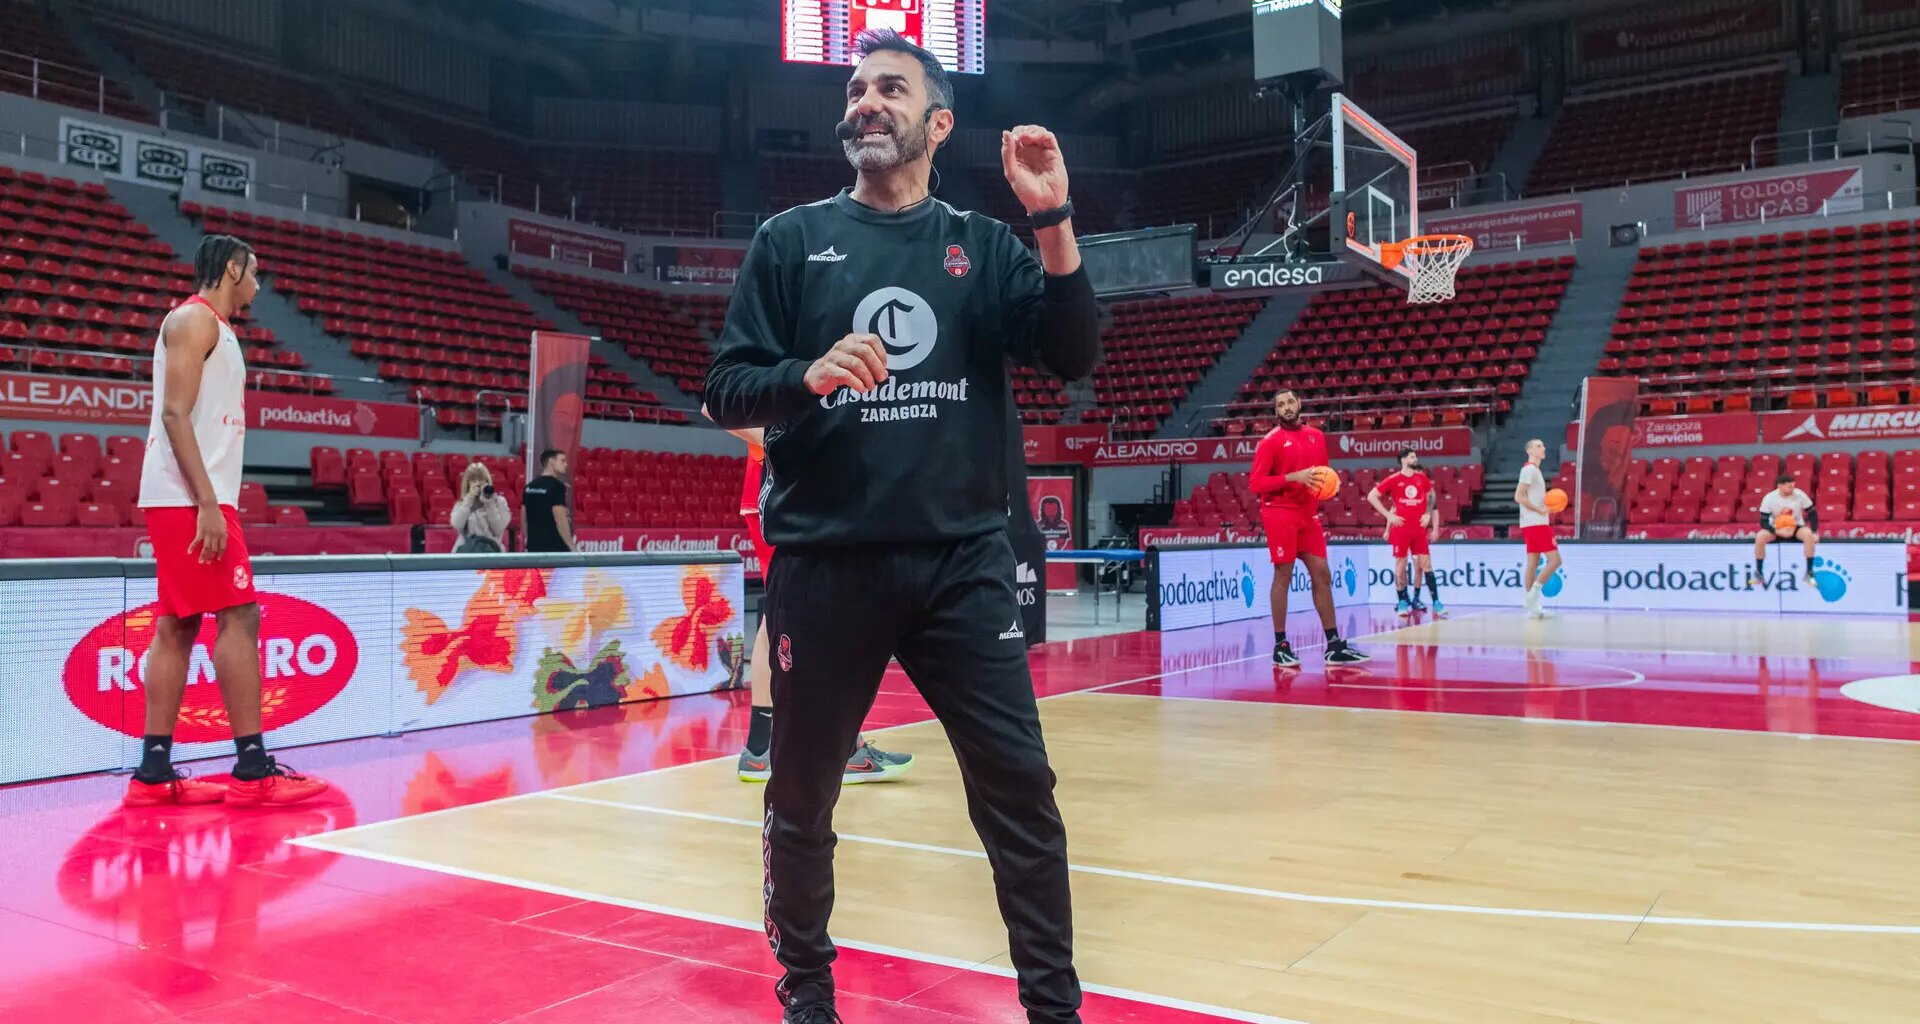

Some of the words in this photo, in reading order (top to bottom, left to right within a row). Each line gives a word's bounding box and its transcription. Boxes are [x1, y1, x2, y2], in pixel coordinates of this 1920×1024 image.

[1729, 179, 1808, 200] TOLDOS
[1733, 197, 1808, 219] LUCAS
[1224, 263, 1322, 287] endesa
[0, 380, 153, 409] LEJANDR
[260, 407, 351, 427] podoactiva
[861, 404, 938, 422] ZARAGOZA
[1828, 411, 1920, 430] MERCU
[1646, 421, 1702, 434] Zaragoza
[1646, 432, 1703, 444] Servicios
[1095, 442, 1198, 459] ALEJANDRO
[637, 533, 719, 551] Casademont
[731, 534, 756, 550] Cas
[1143, 532, 1220, 546] Casademont
[1602, 563, 1799, 601] podoactiva
[98, 633, 337, 692] RMRO
